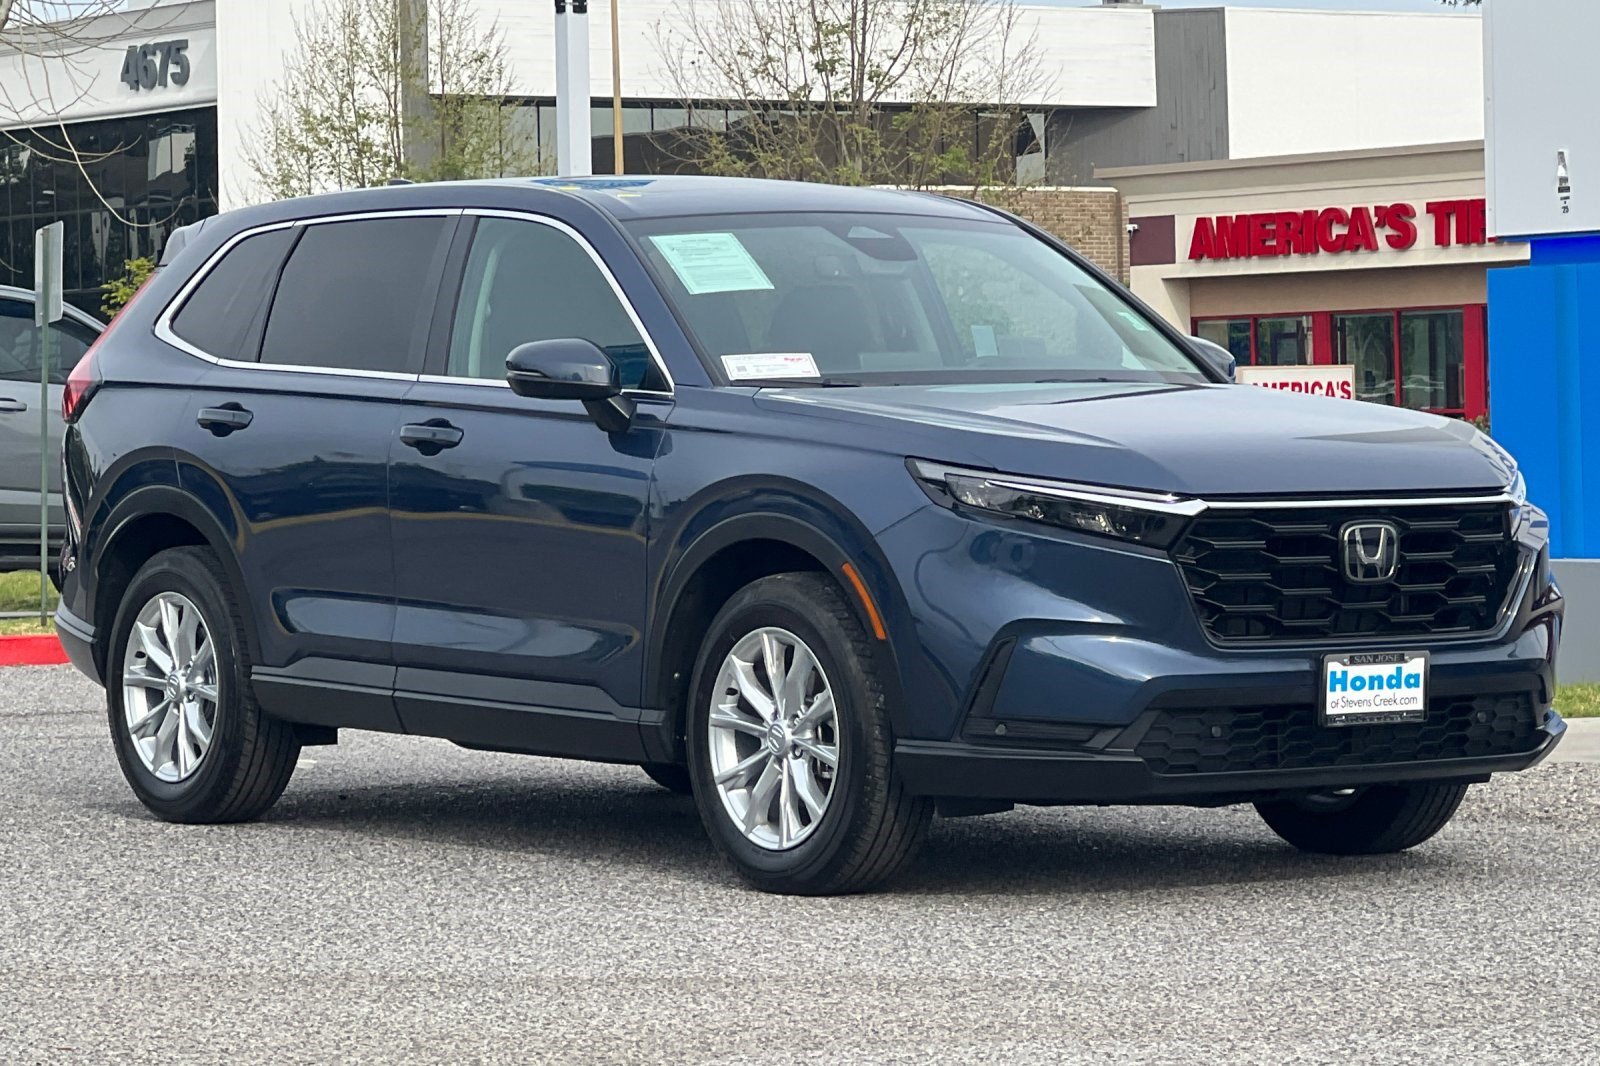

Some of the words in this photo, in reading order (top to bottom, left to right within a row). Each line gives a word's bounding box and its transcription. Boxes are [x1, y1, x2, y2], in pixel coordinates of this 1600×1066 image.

[120, 39, 190, 91] 4675
[1188, 203, 1417, 260] AMERICA'S
[1252, 380, 1352, 400] RICA'S
[1353, 655, 1374, 664] SAN
[1329, 666, 1420, 692] Honda
[1330, 699, 1340, 709] of
[1340, 696, 1373, 709] Stevens
[1373, 692, 1418, 707] Creek.com
